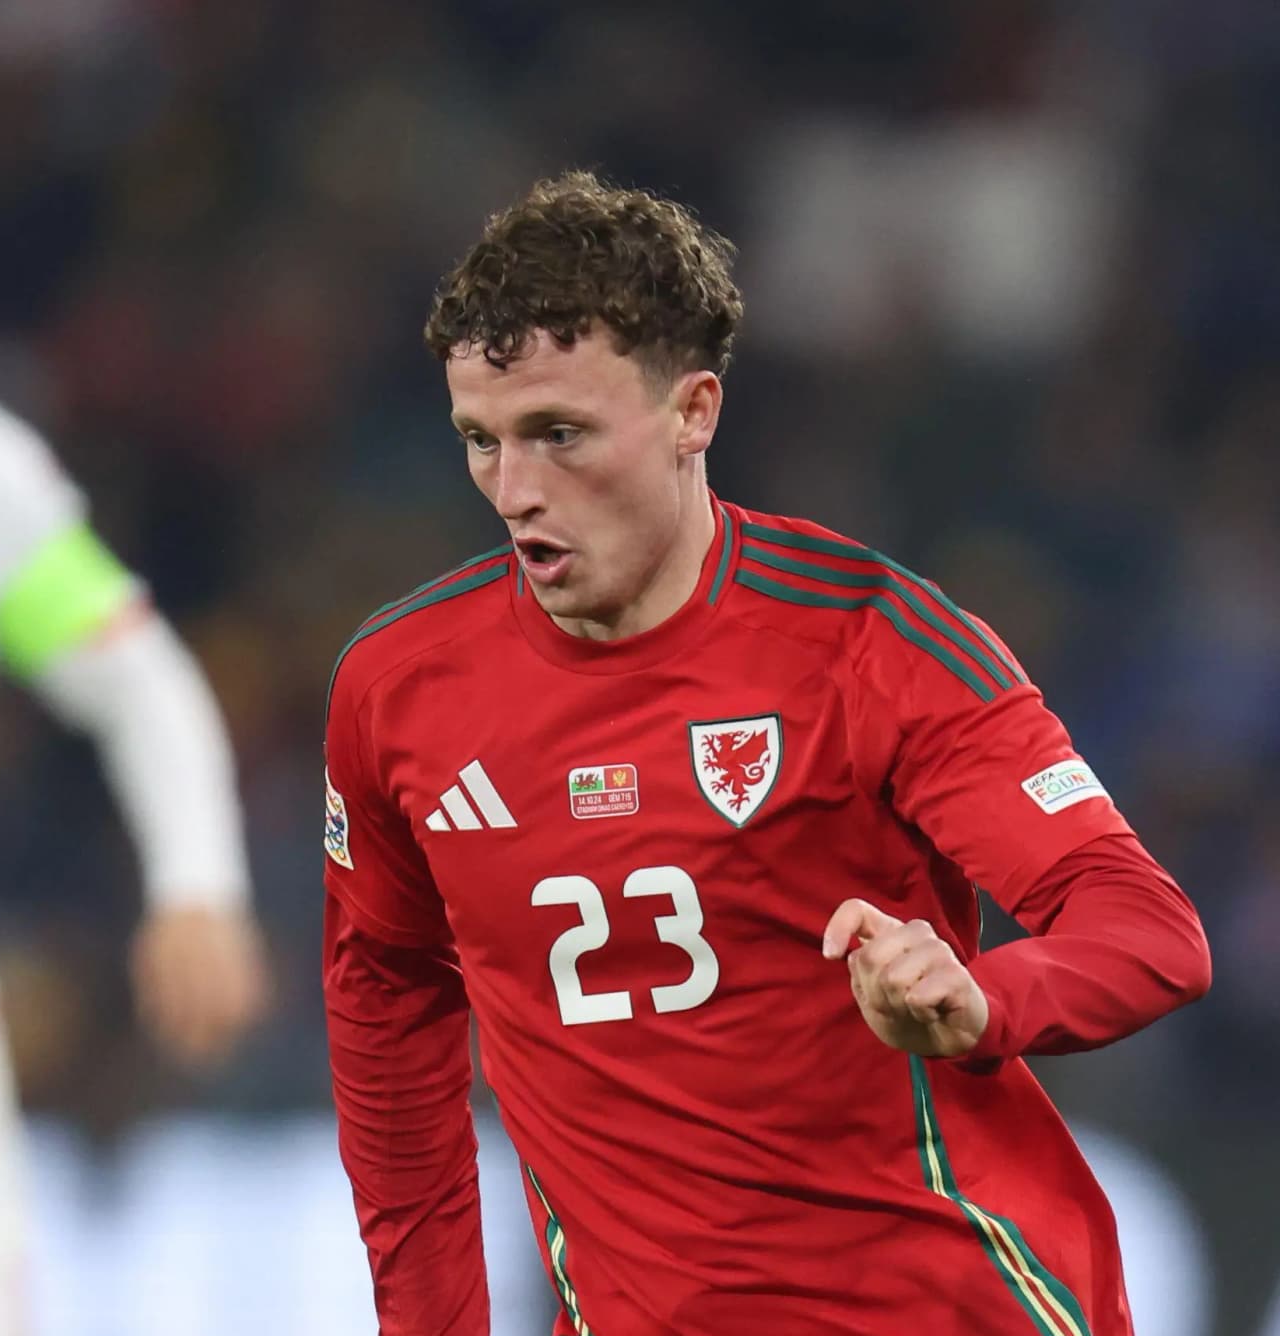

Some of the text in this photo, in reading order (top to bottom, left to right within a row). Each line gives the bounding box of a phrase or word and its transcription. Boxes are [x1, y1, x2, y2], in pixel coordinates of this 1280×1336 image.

[1028, 771, 1056, 790] UEFA
[1035, 772, 1090, 801] FOUN
[531, 865, 719, 1027] 23
